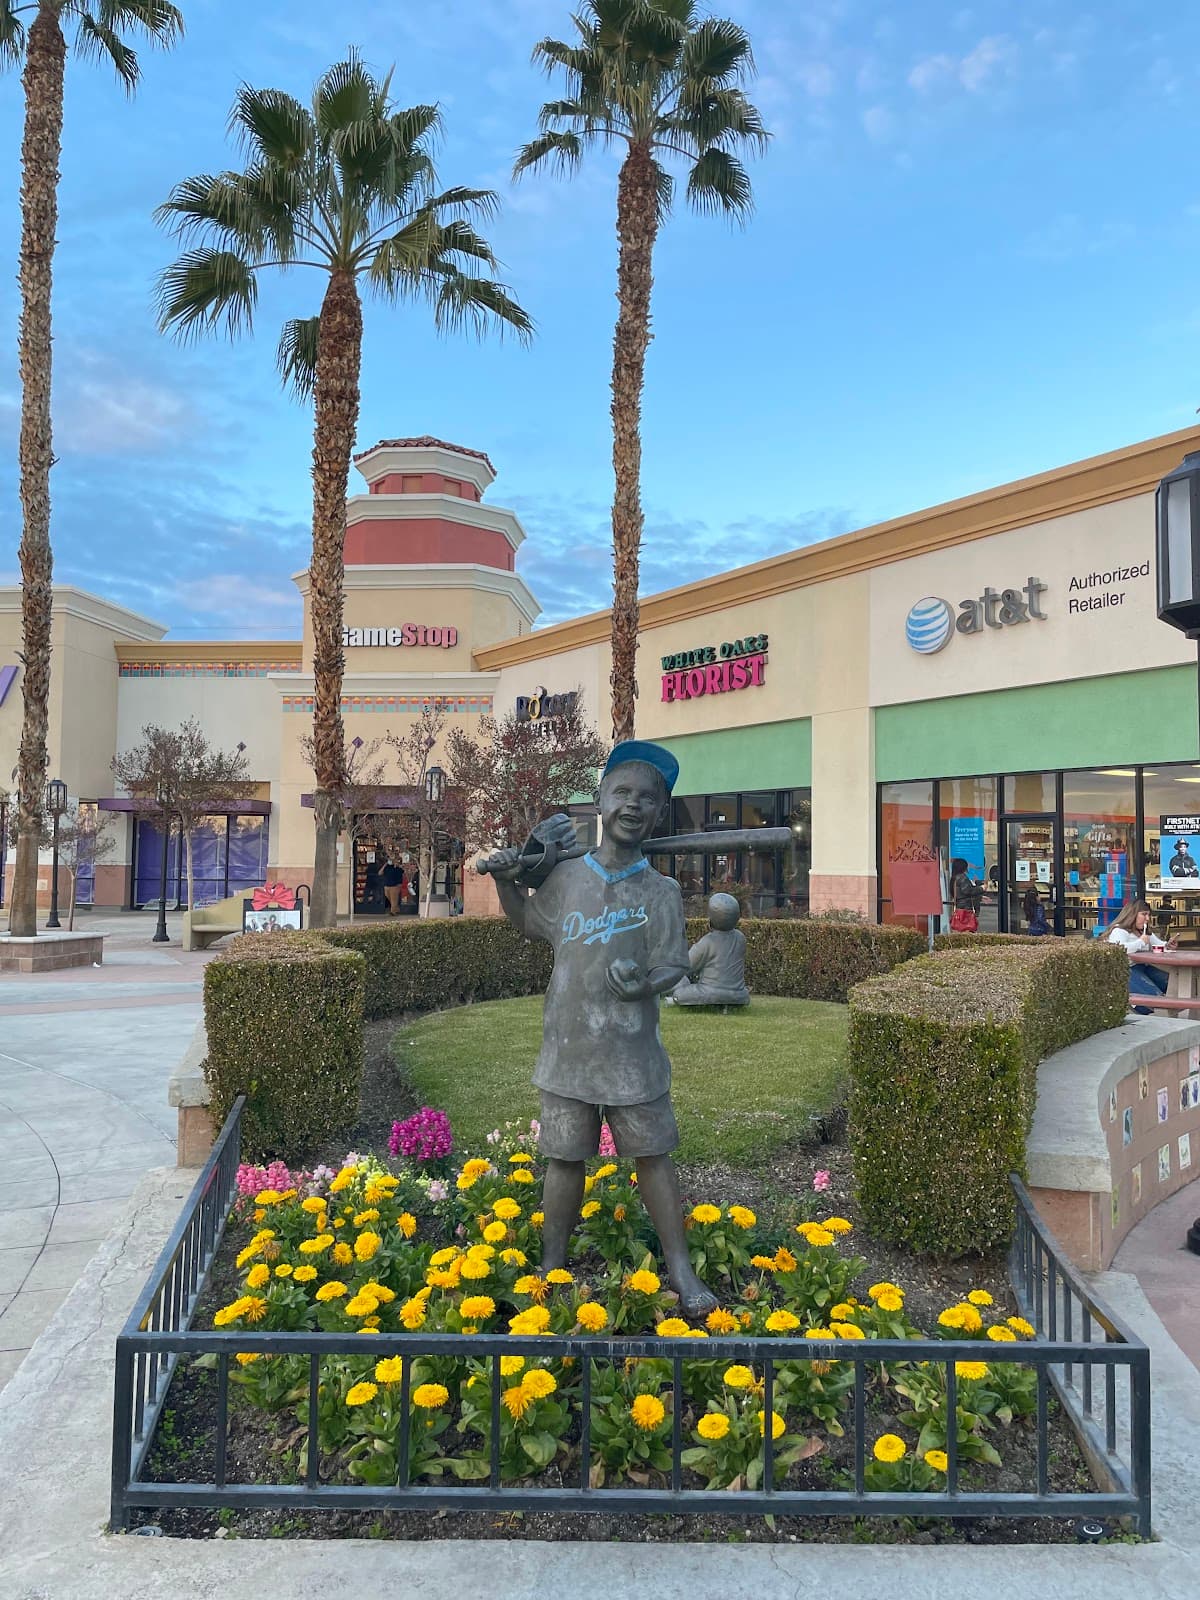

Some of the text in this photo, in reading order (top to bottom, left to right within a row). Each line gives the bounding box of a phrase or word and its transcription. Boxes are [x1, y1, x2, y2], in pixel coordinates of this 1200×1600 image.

[1068, 560, 1150, 592] Authorized
[955, 576, 1049, 635] at&t
[1068, 591, 1126, 614] Retailer
[661, 634, 769, 670] WHITE OAKS
[661, 654, 768, 702] FLORIST
[561, 905, 649, 945] Dodgers
